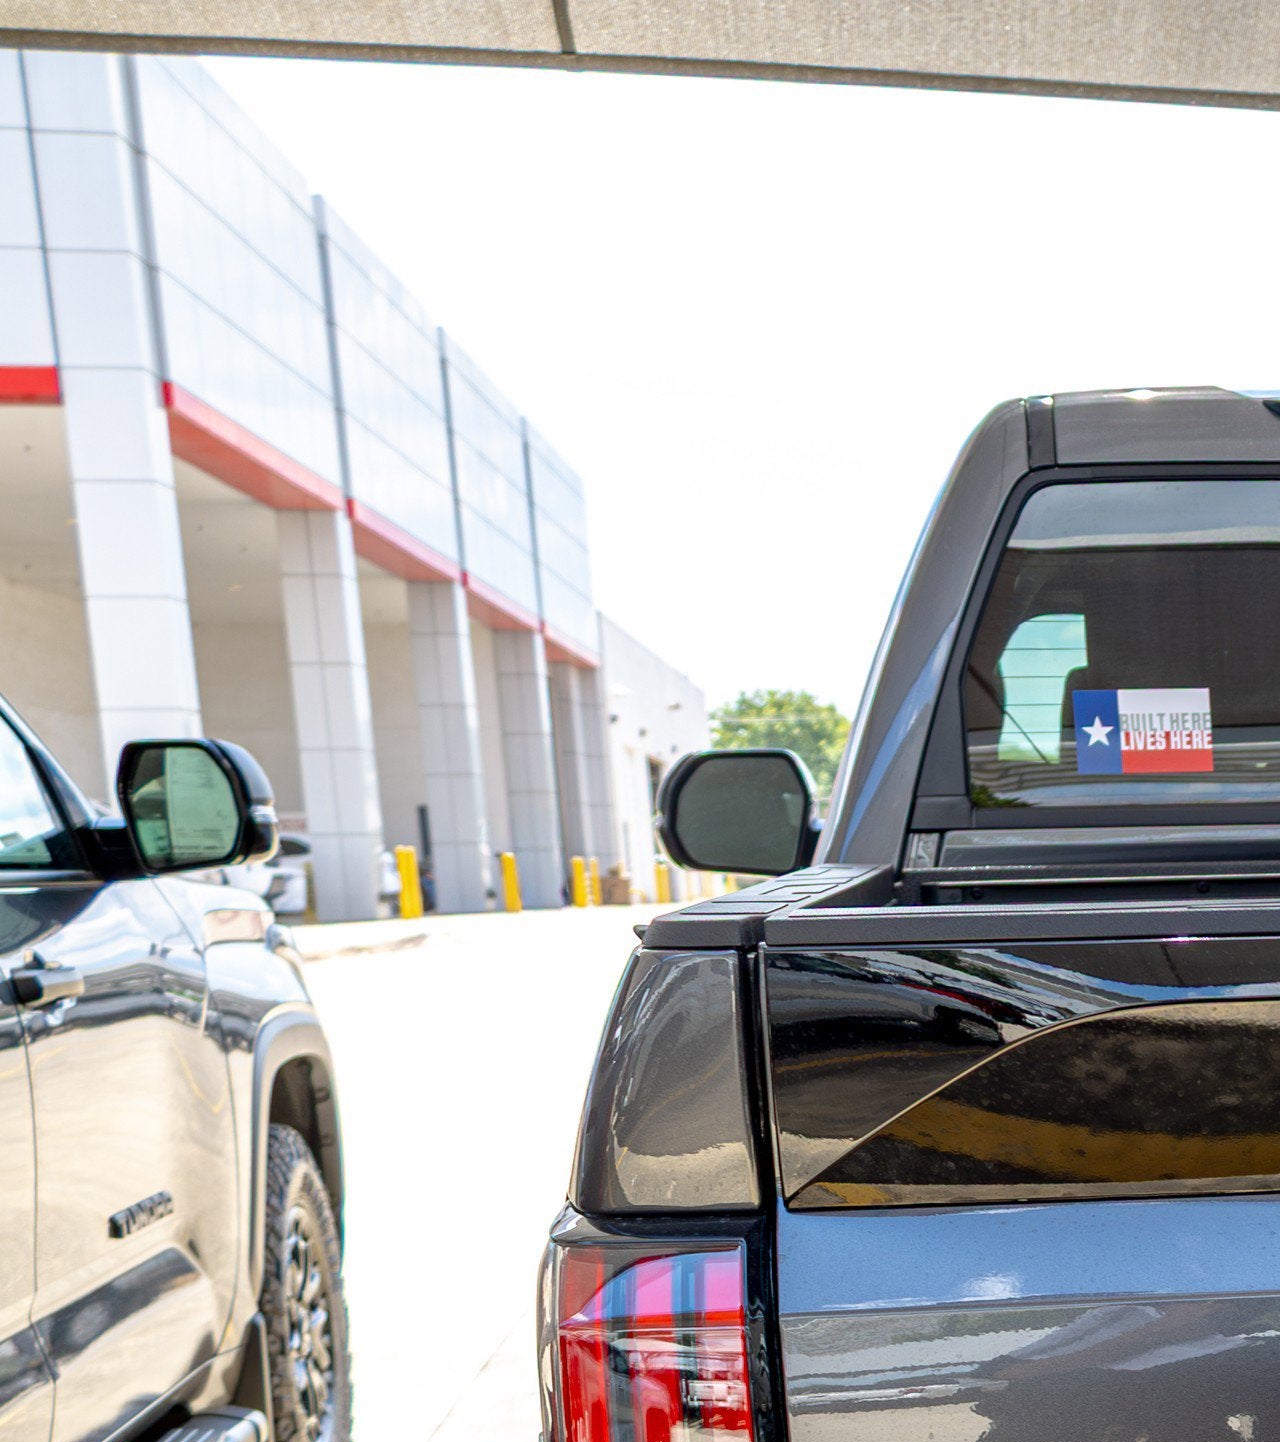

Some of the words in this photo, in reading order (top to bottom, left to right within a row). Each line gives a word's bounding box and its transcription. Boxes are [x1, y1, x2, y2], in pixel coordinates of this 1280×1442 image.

[1120, 712, 1166, 731] BUILT
[1170, 712, 1212, 731] HERE
[1121, 731, 1167, 750] LIVES
[1171, 731, 1213, 750] HERE
